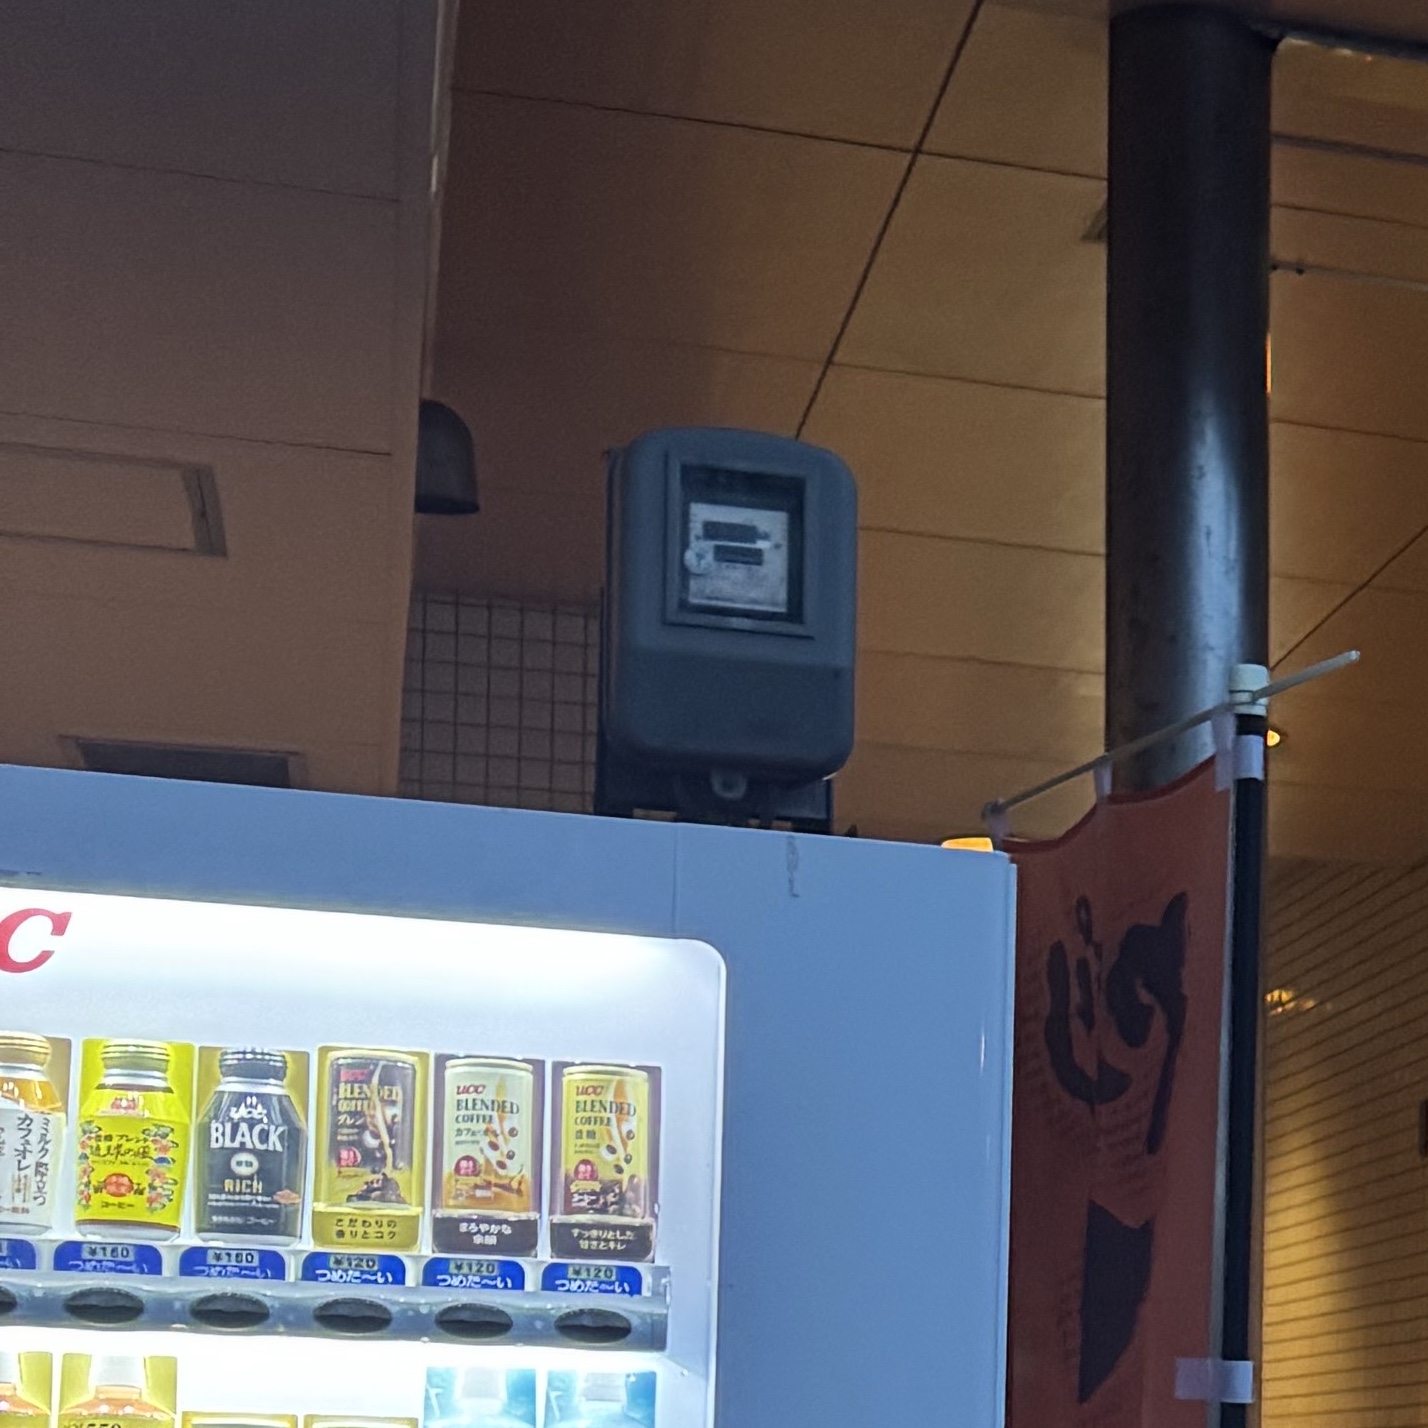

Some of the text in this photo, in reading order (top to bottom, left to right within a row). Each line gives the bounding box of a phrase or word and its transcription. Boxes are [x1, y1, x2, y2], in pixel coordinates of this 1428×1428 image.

[456, 1098, 520, 1115] BLENDED
[575, 1099, 637, 1118] BLENDED
[13, 1113, 34, 1172] カフェオレ
[209, 1120, 284, 1152] BLACK
[332, 1256, 377, 1269] ¥120
[453, 1262, 495, 1275] ¥120
[314, 1269, 393, 1284] つめた〜い
[436, 1273, 513, 1289] つめた〜い
[572, 1267, 613, 1279] ¥120
